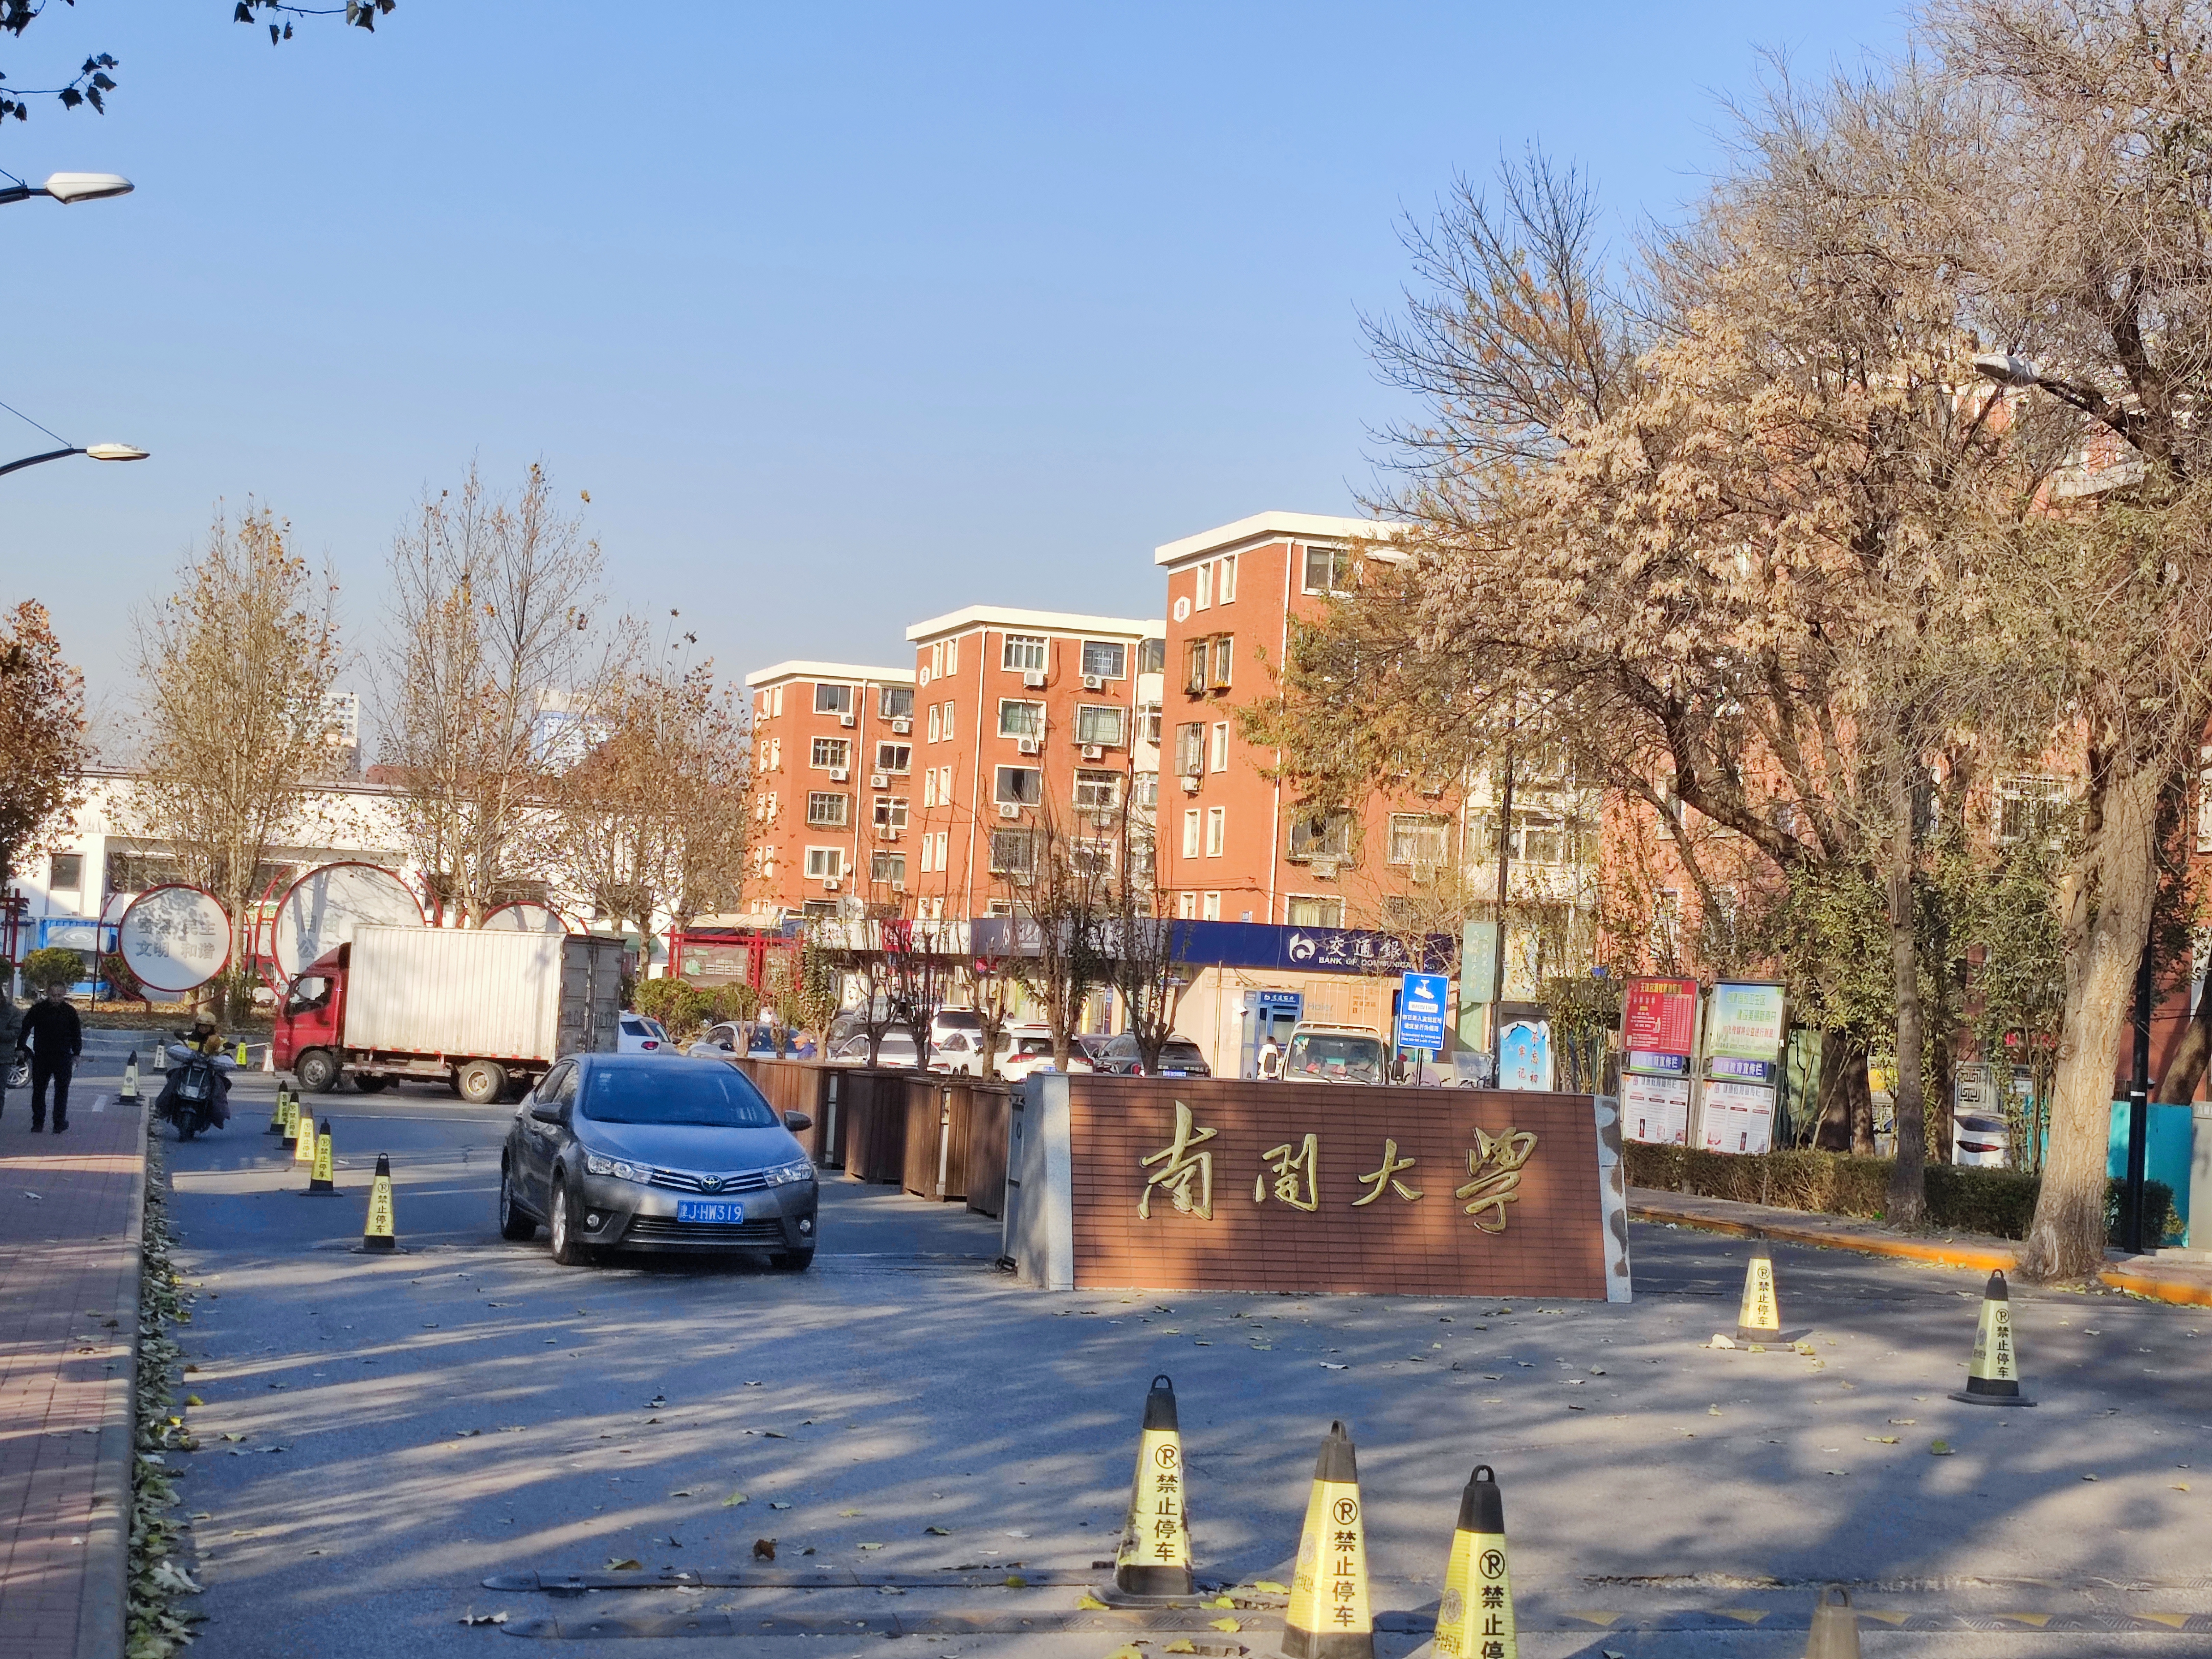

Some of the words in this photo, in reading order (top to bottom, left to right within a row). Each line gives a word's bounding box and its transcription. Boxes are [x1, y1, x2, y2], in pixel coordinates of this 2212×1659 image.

[135, 940, 170, 958] 文明
[181, 942, 215, 959] 和谐
[1319, 956, 1342, 965] BANK
[318, 1147, 328, 1178] 禁止停车
[375, 1194, 388, 1234] 禁止停车
[1757, 1282, 1770, 1327] 禁止停车
[1996, 1326, 2010, 1378] 禁止停车
[1155, 1473, 1178, 1563] 禁止停车
[1332, 1530, 1356, 1627] 禁止停车
